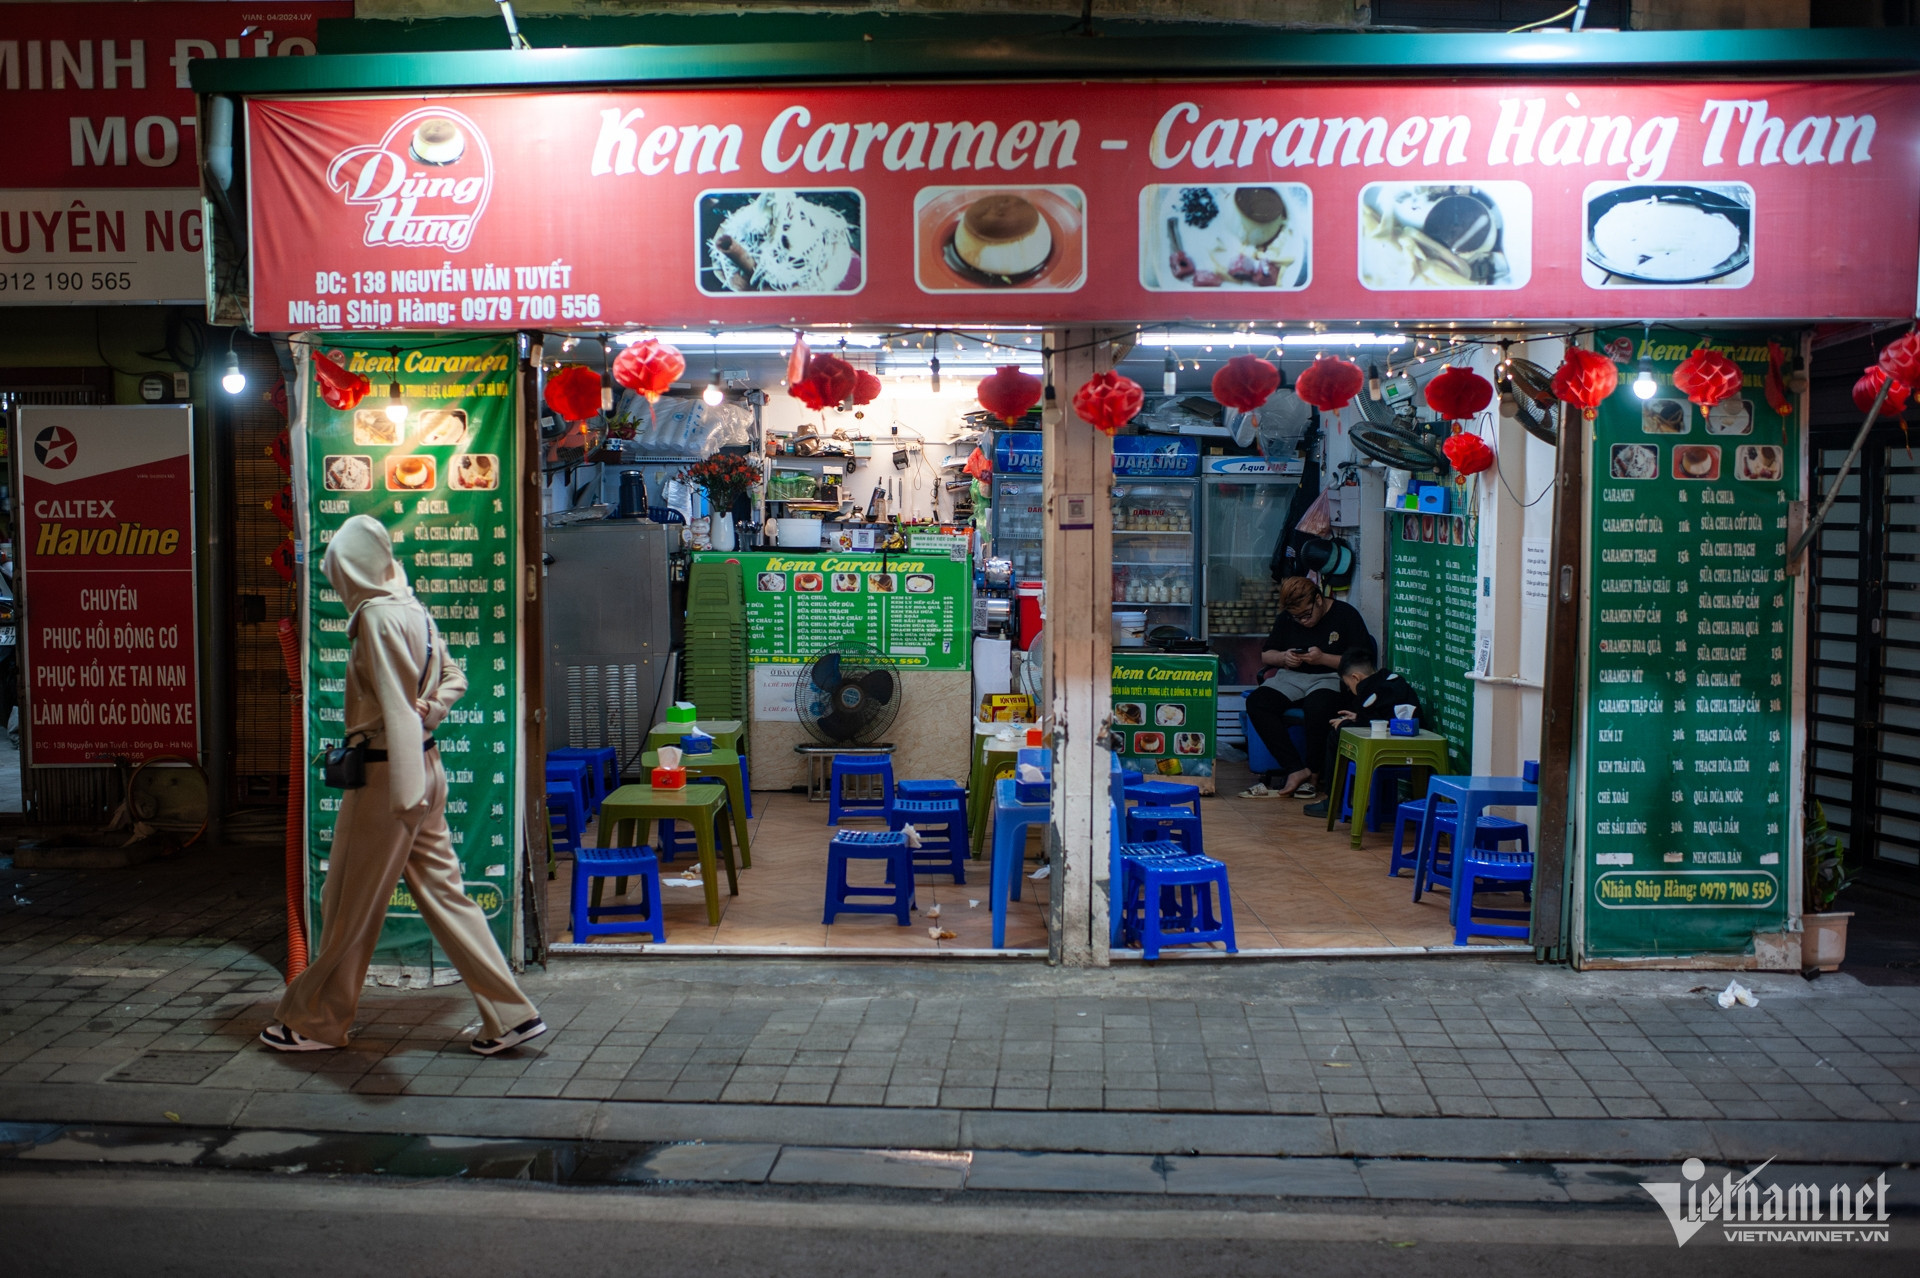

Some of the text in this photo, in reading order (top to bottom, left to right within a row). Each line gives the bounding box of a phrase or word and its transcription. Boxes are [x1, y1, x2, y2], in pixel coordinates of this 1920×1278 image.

[591, 106, 741, 176] Kem
[760, 104, 1081, 174] Caramen
[1149, 102, 1472, 170] Caramen
[1487, 92, 1679, 183] Hàng
[1701, 99, 1877, 167] Than
[329, 150, 484, 204] Dũng
[45, 272, 83, 290] 190
[92, 272, 131, 290] 565
[315, 257, 572, 294] ĐC: 138 NGUYỄN VĂN TUYẾT
[347, 299, 392, 325] Ship
[398, 298, 456, 325] Hàng:
[461, 296, 512, 321] 0979
[517, 295, 555, 320] 700
[561, 293, 600, 318] 556
[348, 351, 400, 373] Kem
[404, 350, 509, 374] Caramen
[1113, 455, 1188, 469] DARLING
[1239, 463, 1265, 472] Aqua
[1603, 489, 1635, 502] CARAMEN
[1716, 490, 1734, 504] CHUA
[34, 500, 116, 519] CALTEX
[320, 500, 350, 513] CARAMEN
[430, 500, 449, 514] CHUA
[1602, 519, 1634, 532] CARAMEN
[1715, 517, 1733, 530] CHUA
[35, 522, 180, 556] Havoline
[430, 527, 448, 540] CHUA
[430, 553, 448, 567] CHUA
[765, 557, 925, 572] Kem Caramen
[80, 584, 138, 610] CHUYÊN
[43, 619, 178, 654] PHỤC HỒI ĐỘNG CƠ
[37, 657, 186, 692] PHỤC HỒI XE TAI NẠN
[1112, 665, 1213, 681] Kem Caramen
[33, 698, 193, 725] LÀM MỚI CÁC DÒNG XE
[1599, 700, 1630, 713] CARAMEN
[1710, 700, 1728, 713] CHUA
[53, 741, 65, 749] 138
[1708, 852, 1726, 864] CHUA
[1601, 880, 1772, 903] Nhận Ship Hàng: 0979 700 556
